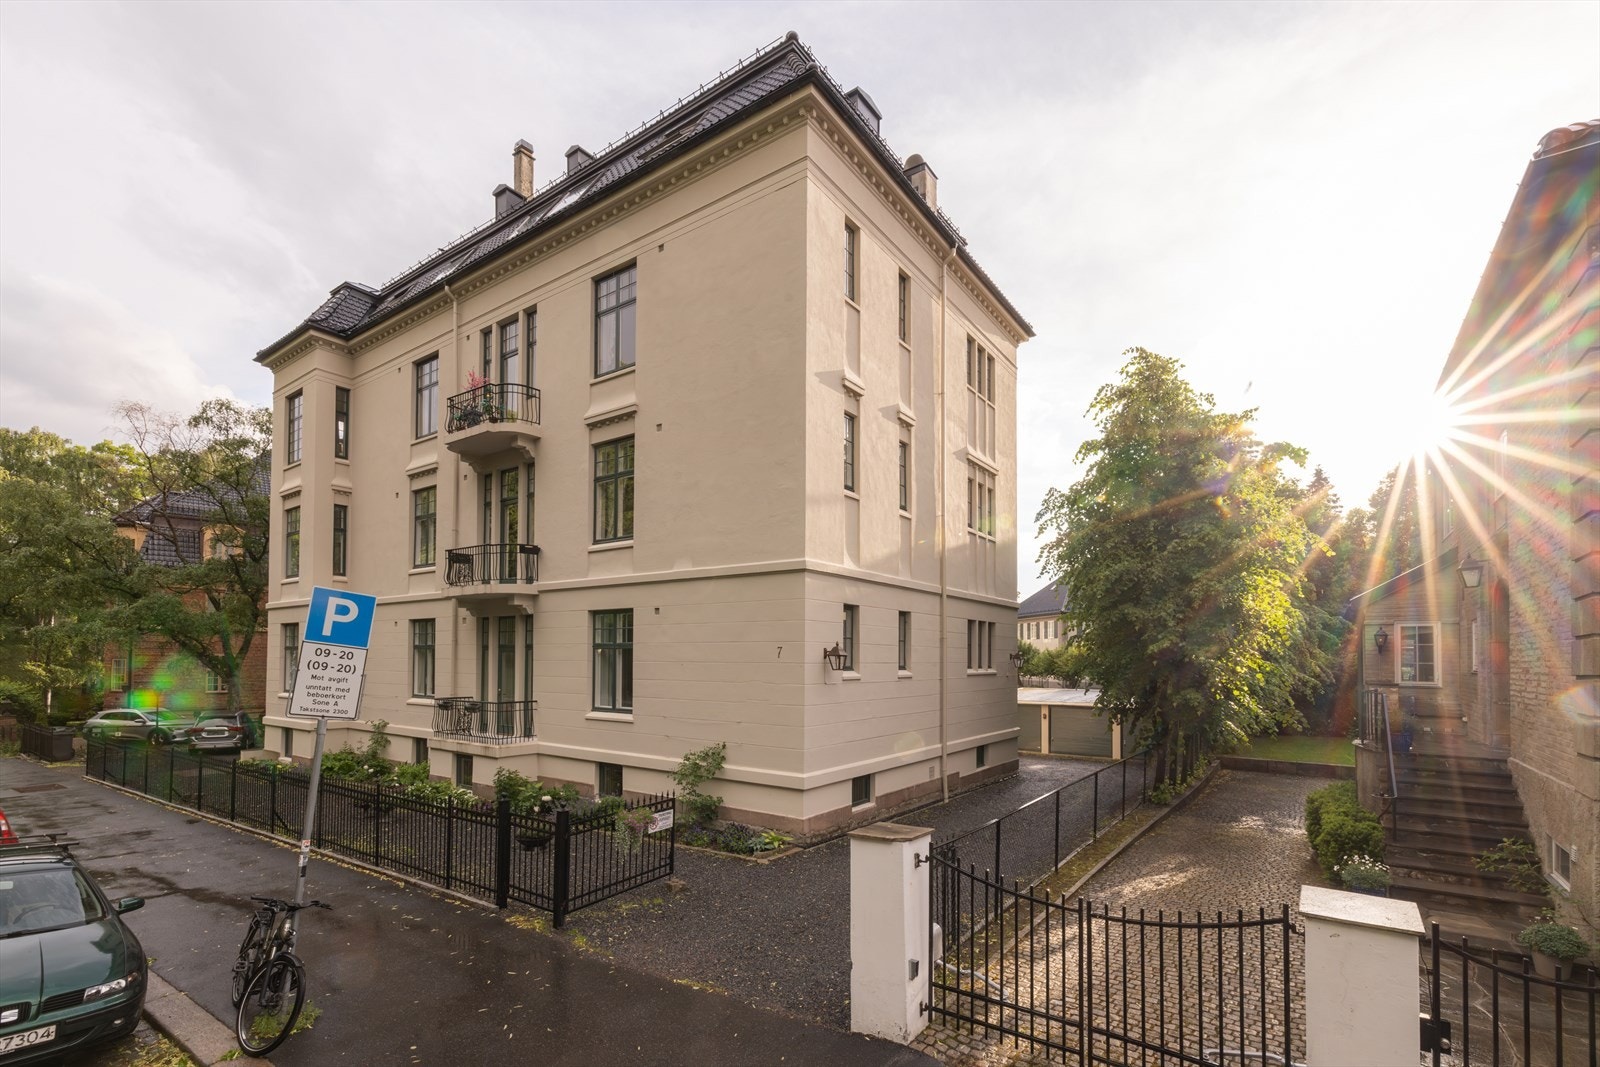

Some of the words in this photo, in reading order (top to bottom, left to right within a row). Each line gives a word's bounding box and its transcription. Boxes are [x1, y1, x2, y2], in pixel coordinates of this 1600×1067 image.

[322, 597, 359, 636] P
[777, 646, 783, 659] 7
[307, 692, 346, 700] beboerkort
